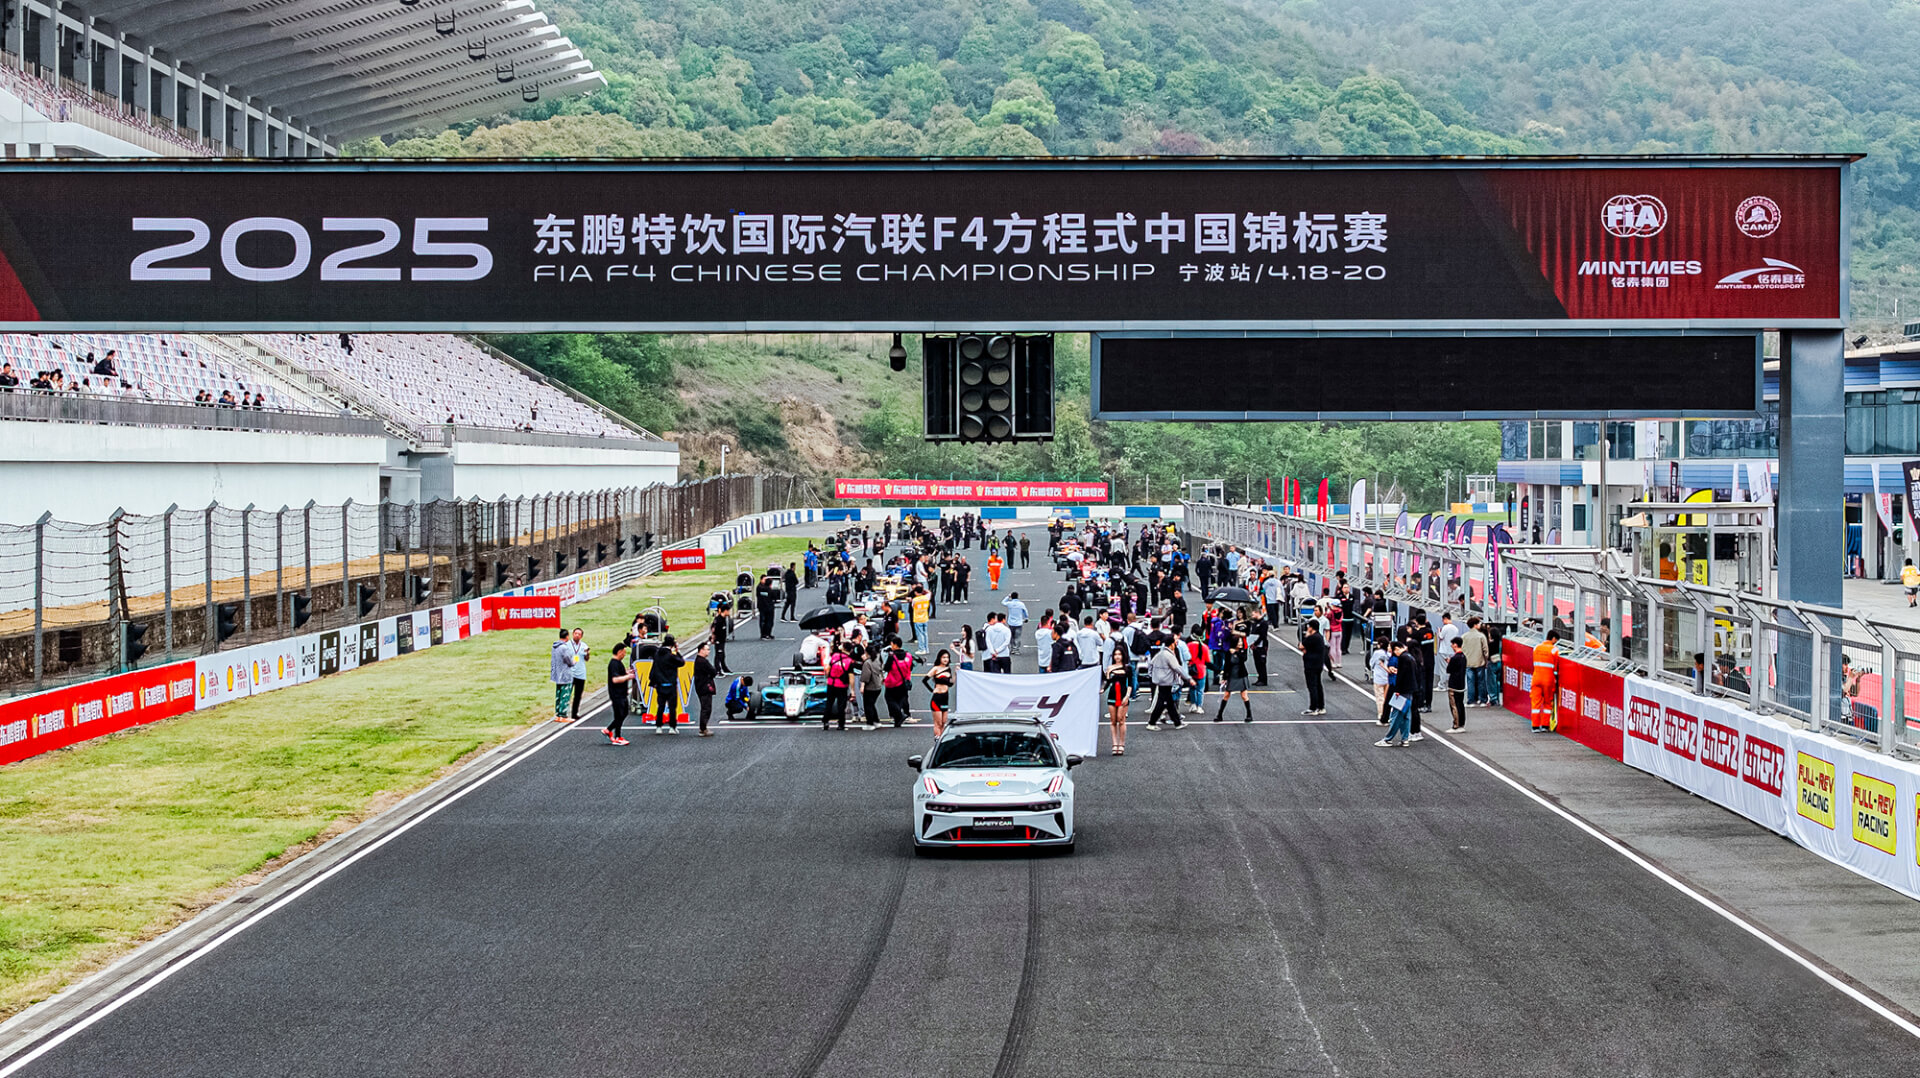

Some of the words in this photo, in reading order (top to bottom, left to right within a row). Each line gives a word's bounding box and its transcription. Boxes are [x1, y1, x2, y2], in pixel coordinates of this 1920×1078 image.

[533, 212, 1389, 256] 东鹏特饮国际汽联F4方程式中国锦标赛
[1741, 223, 1775, 231] CAMF
[130, 217, 494, 282] 2025
[533, 264, 593, 282] FIA
[606, 264, 657, 282] F4
[670, 264, 843, 282] CHINESE
[856, 264, 1156, 283] CHAMPIONSHIP
[1577, 260, 1703, 275] MINTIMES
[1611, 277, 1669, 288] 铭泰集团
[509, 607, 556, 619] 东鹏特饮
[1801, 788, 1829, 813] RACING
[1857, 811, 1889, 838] RACING
